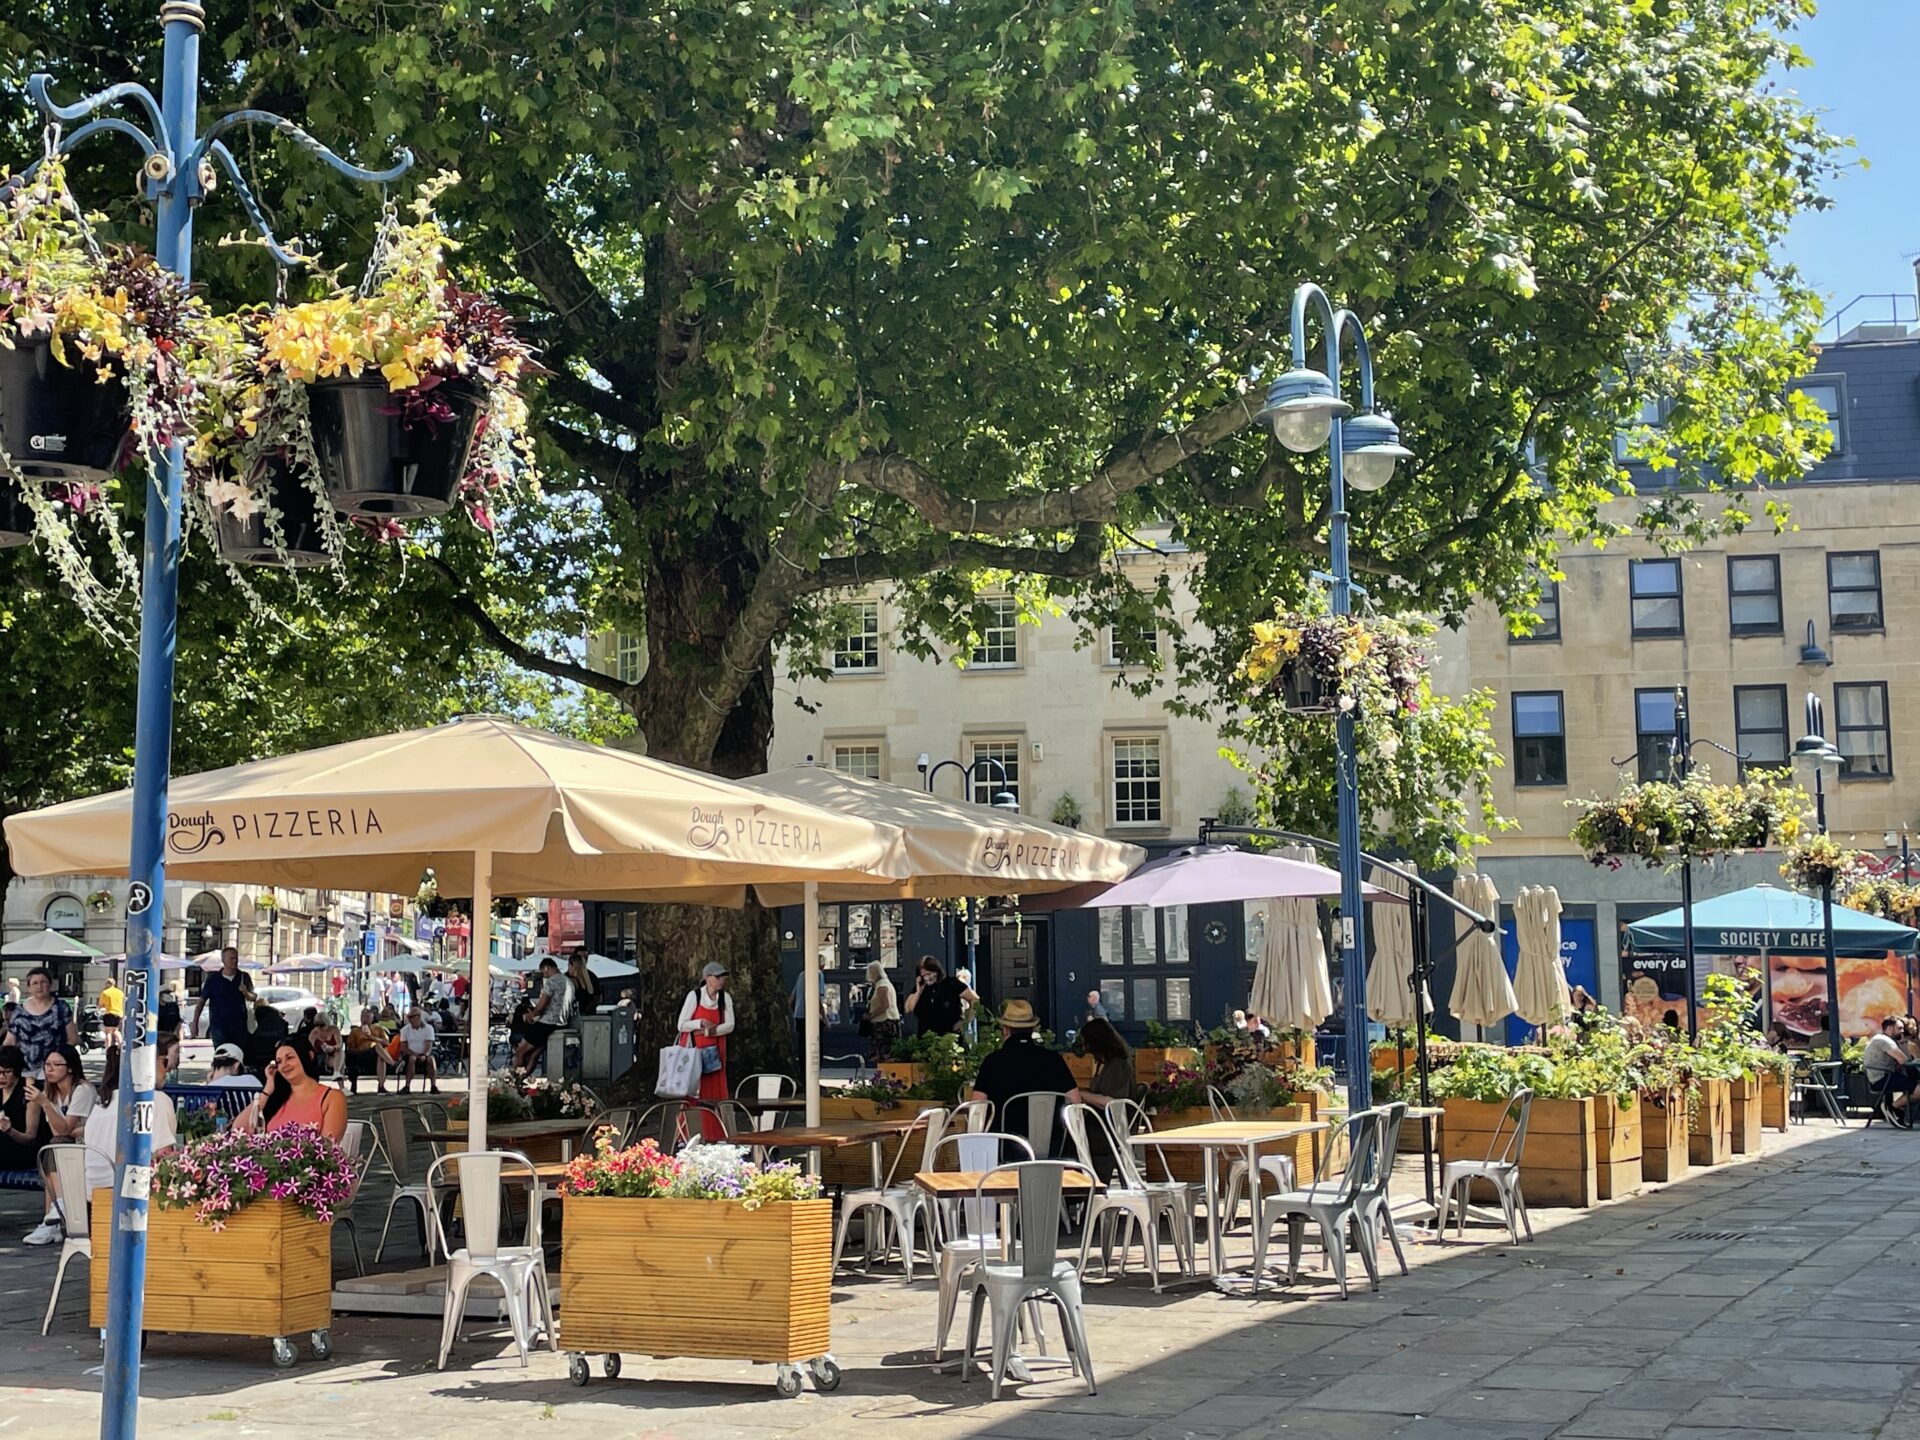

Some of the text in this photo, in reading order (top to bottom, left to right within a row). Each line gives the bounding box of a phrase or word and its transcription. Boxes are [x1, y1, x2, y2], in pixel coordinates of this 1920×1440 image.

[232, 807, 383, 840] PIZZERIA
[735, 817, 823, 853] PIZZERIA
[1015, 843, 1082, 869] PIZZERIA
[1561, 941, 1577, 950] ce
[1719, 931, 1780, 946] SOCIETY
[1633, 957, 1687, 971] every da
[1068, 971, 1075, 981] 3
